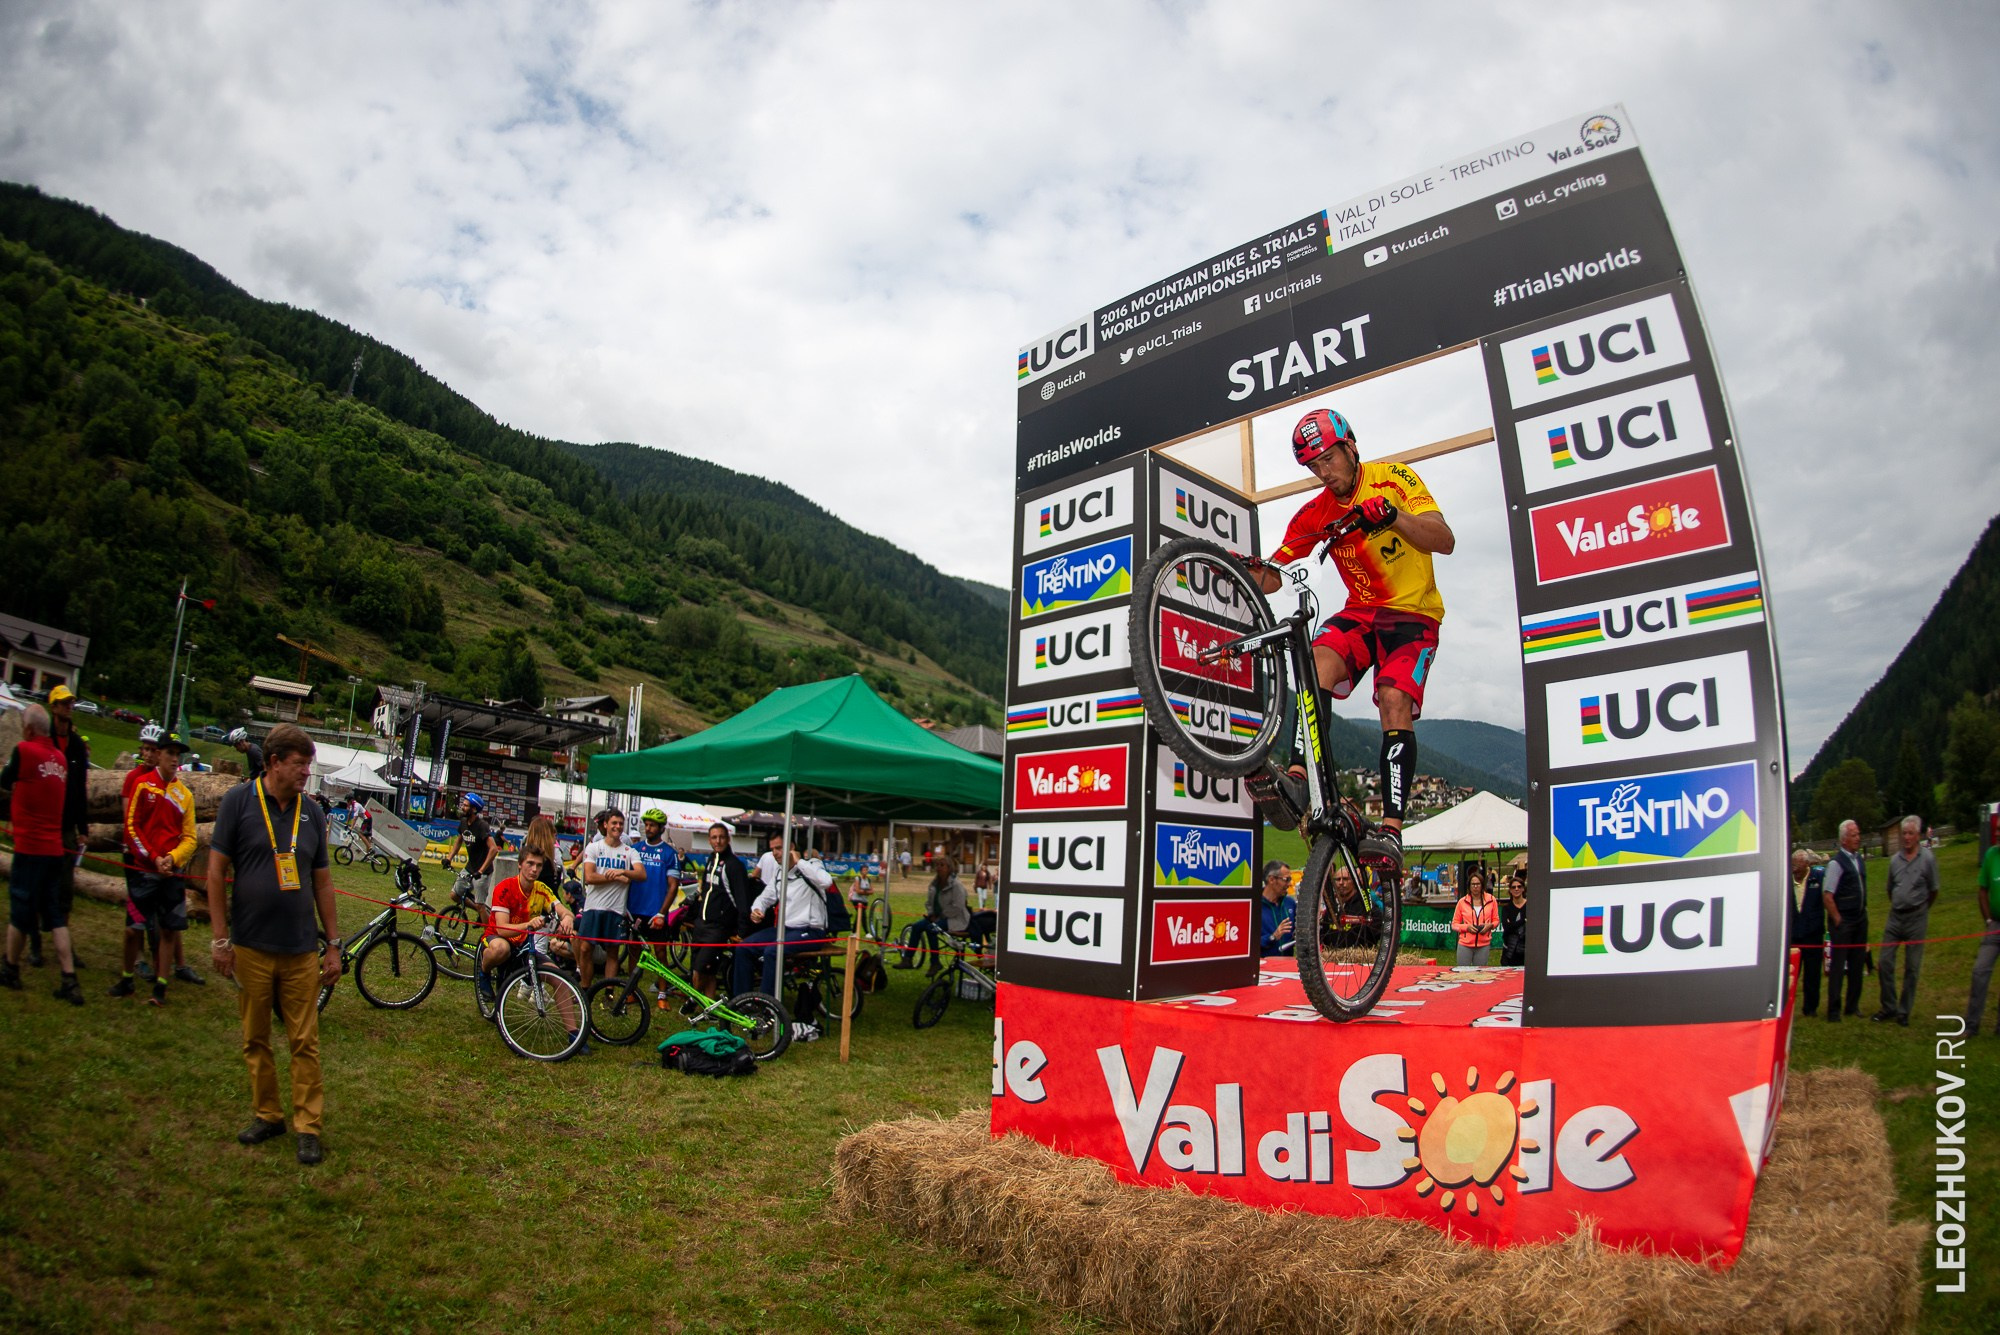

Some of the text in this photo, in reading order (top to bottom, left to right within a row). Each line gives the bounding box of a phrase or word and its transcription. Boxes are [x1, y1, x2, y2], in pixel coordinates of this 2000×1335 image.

[1335, 202, 1366, 225] VAL
[1368, 195, 1386, 213] DI
[1390, 177, 1435, 205] SOLE
[1449, 140, 1536, 183] TRENTINO
[1524, 172, 1607, 209] uci_cycling
[1339, 216, 1379, 242] ITALY
[1391, 224, 1450, 256] tv.uci.ch
[1100, 222, 1318, 328] 2016 MOUNTAIN BIKE & TRIALS
[1493, 246, 1642, 308] #TrialsWorlds
[1100, 254, 1283, 343] WORLD CHAMPIONSHIPS
[1029, 322, 1089, 373] UCI
[1137, 319, 1203, 358] @UCI_Trials
[1227, 313, 1372, 402] START
[1552, 315, 1656, 377] UCI
[1057, 369, 1087, 391] uci.ch
[1027, 424, 1122, 473] #TrialsWorlds
[1570, 398, 1678, 461] UCI
[1053, 486, 1114, 532] UCI
[1187, 493, 1239, 545] UCI
[1556, 502, 1701, 557] Val di Sole
[1035, 553, 1117, 596] TRENTINO
[1291, 567, 1309, 586] 2D
[1603, 596, 1679, 640] UCI
[1048, 623, 1112, 667] UCI
[1049, 700, 1091, 729] UCI
[1188, 702, 1226, 734] UCI
[1605, 676, 1720, 741] UCI
[1028, 764, 1112, 797] Val di Sole
[1187, 769, 1240, 804] UCI
[1579, 786, 1730, 841] TRENTINO
[595, 857, 626, 870] ITALIA
[1041, 835, 1106, 872] UCI
[1170, 835, 1242, 871] TRENTINO
[1038, 907, 1103, 948] UCI
[1167, 915, 1240, 948] Val di Sole
[1405, 918, 1452, 935] Heineken
[1609, 896, 1725, 954] UCI
[1095, 1044, 1246, 1178] Val
[1256, 1110, 1335, 1185] di
[1337, 1053, 1641, 1195] Sole
